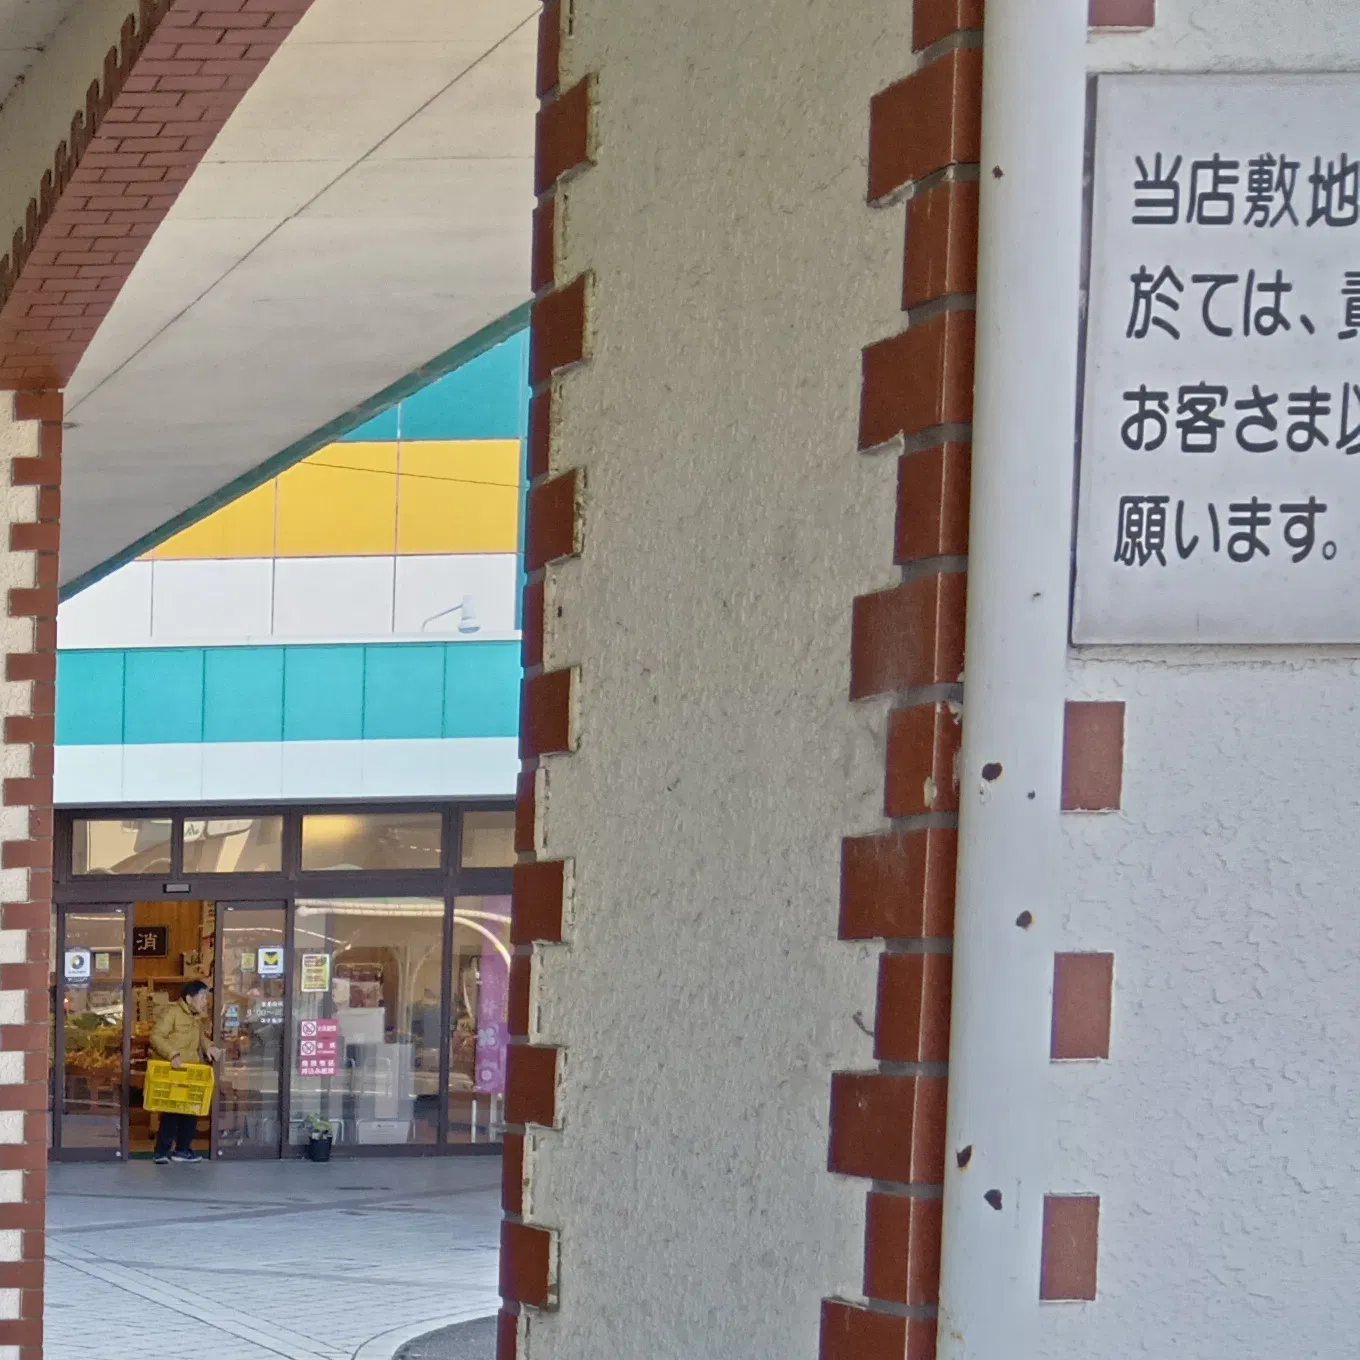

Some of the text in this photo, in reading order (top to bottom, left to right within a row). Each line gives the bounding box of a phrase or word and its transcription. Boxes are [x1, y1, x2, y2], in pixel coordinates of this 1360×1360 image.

[1131, 151, 1360, 228] 当店敷地
[1113, 494, 1337, 567] 願います。
